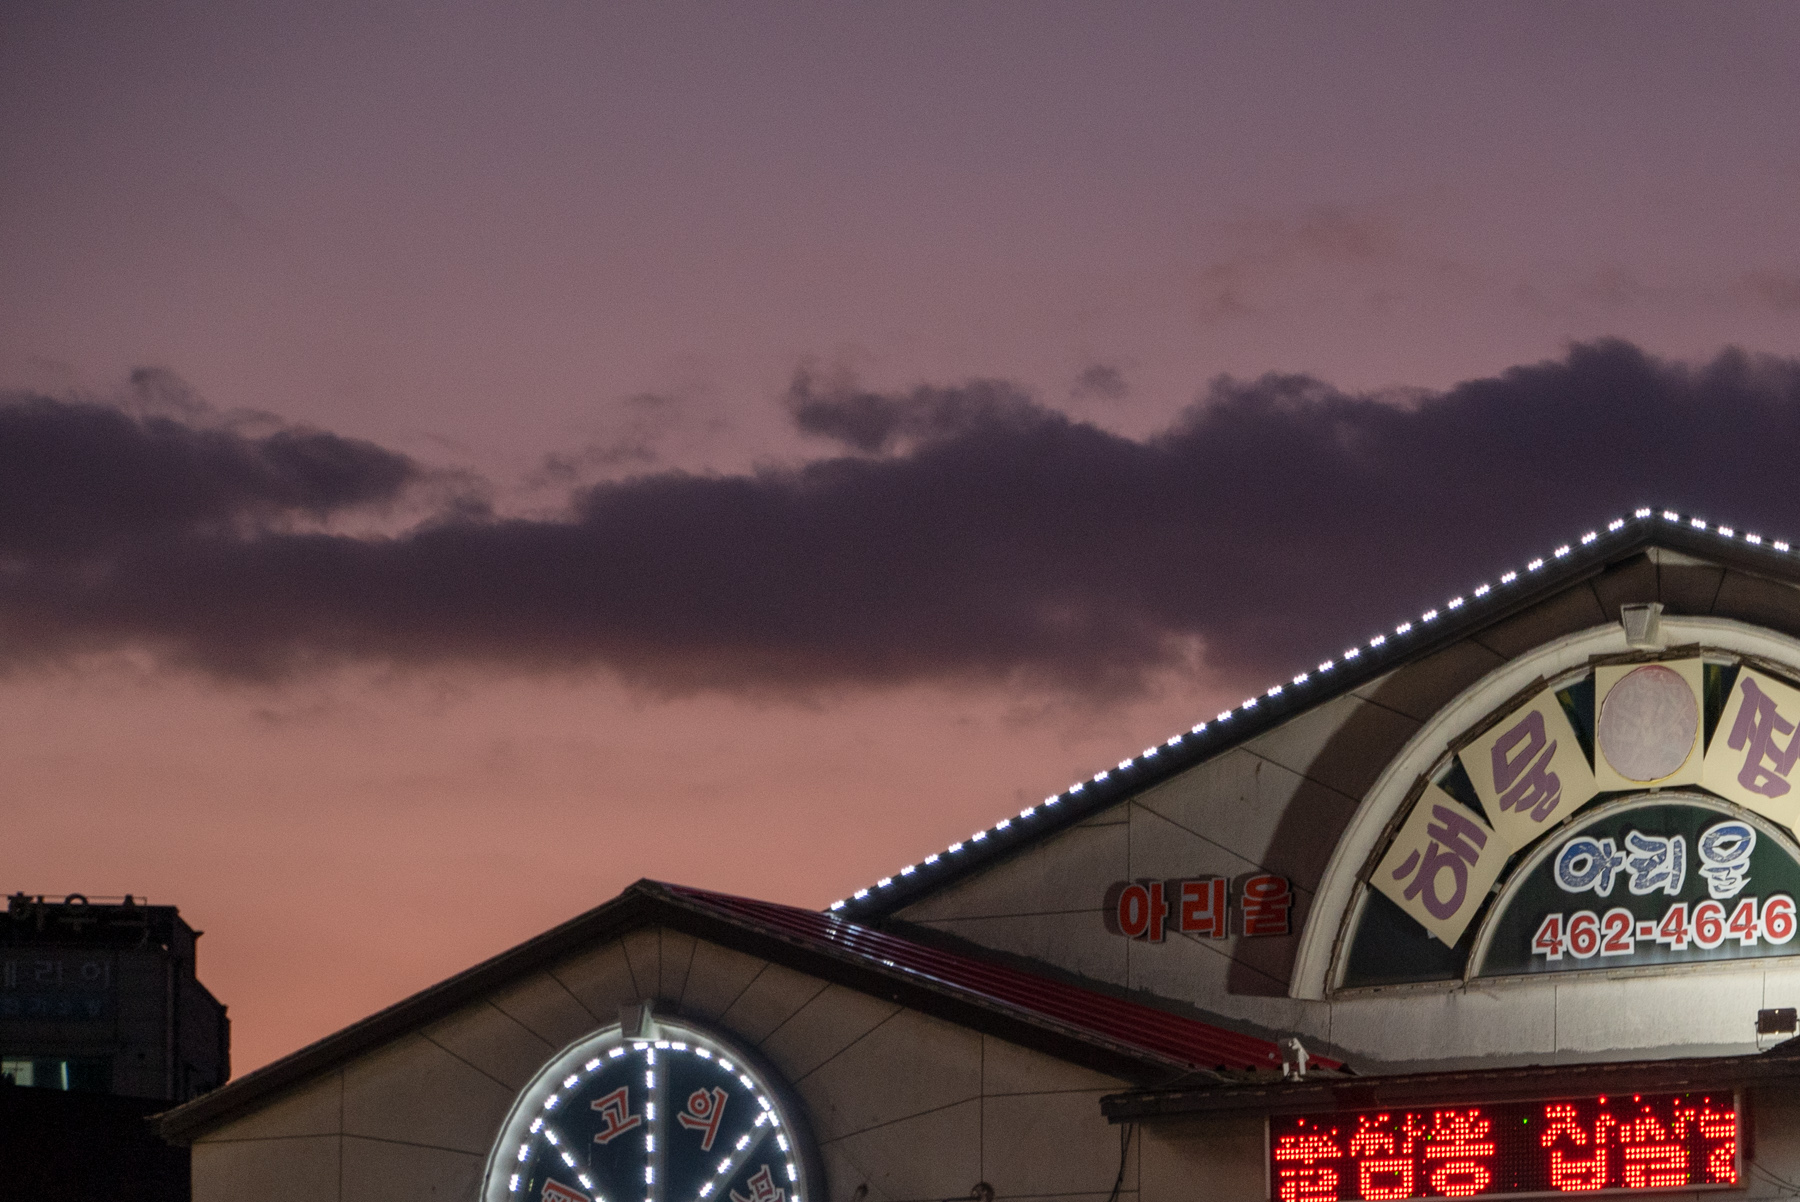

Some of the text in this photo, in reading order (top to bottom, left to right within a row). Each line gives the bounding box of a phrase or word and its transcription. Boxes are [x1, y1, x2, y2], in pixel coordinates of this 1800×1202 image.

[1391, 709, 1561, 921] 해물
[1553, 821, 1758, 900] 아리울
[1118, 876, 1292, 943] 아리울
[1531, 895, 1798, 962] 462-4646
